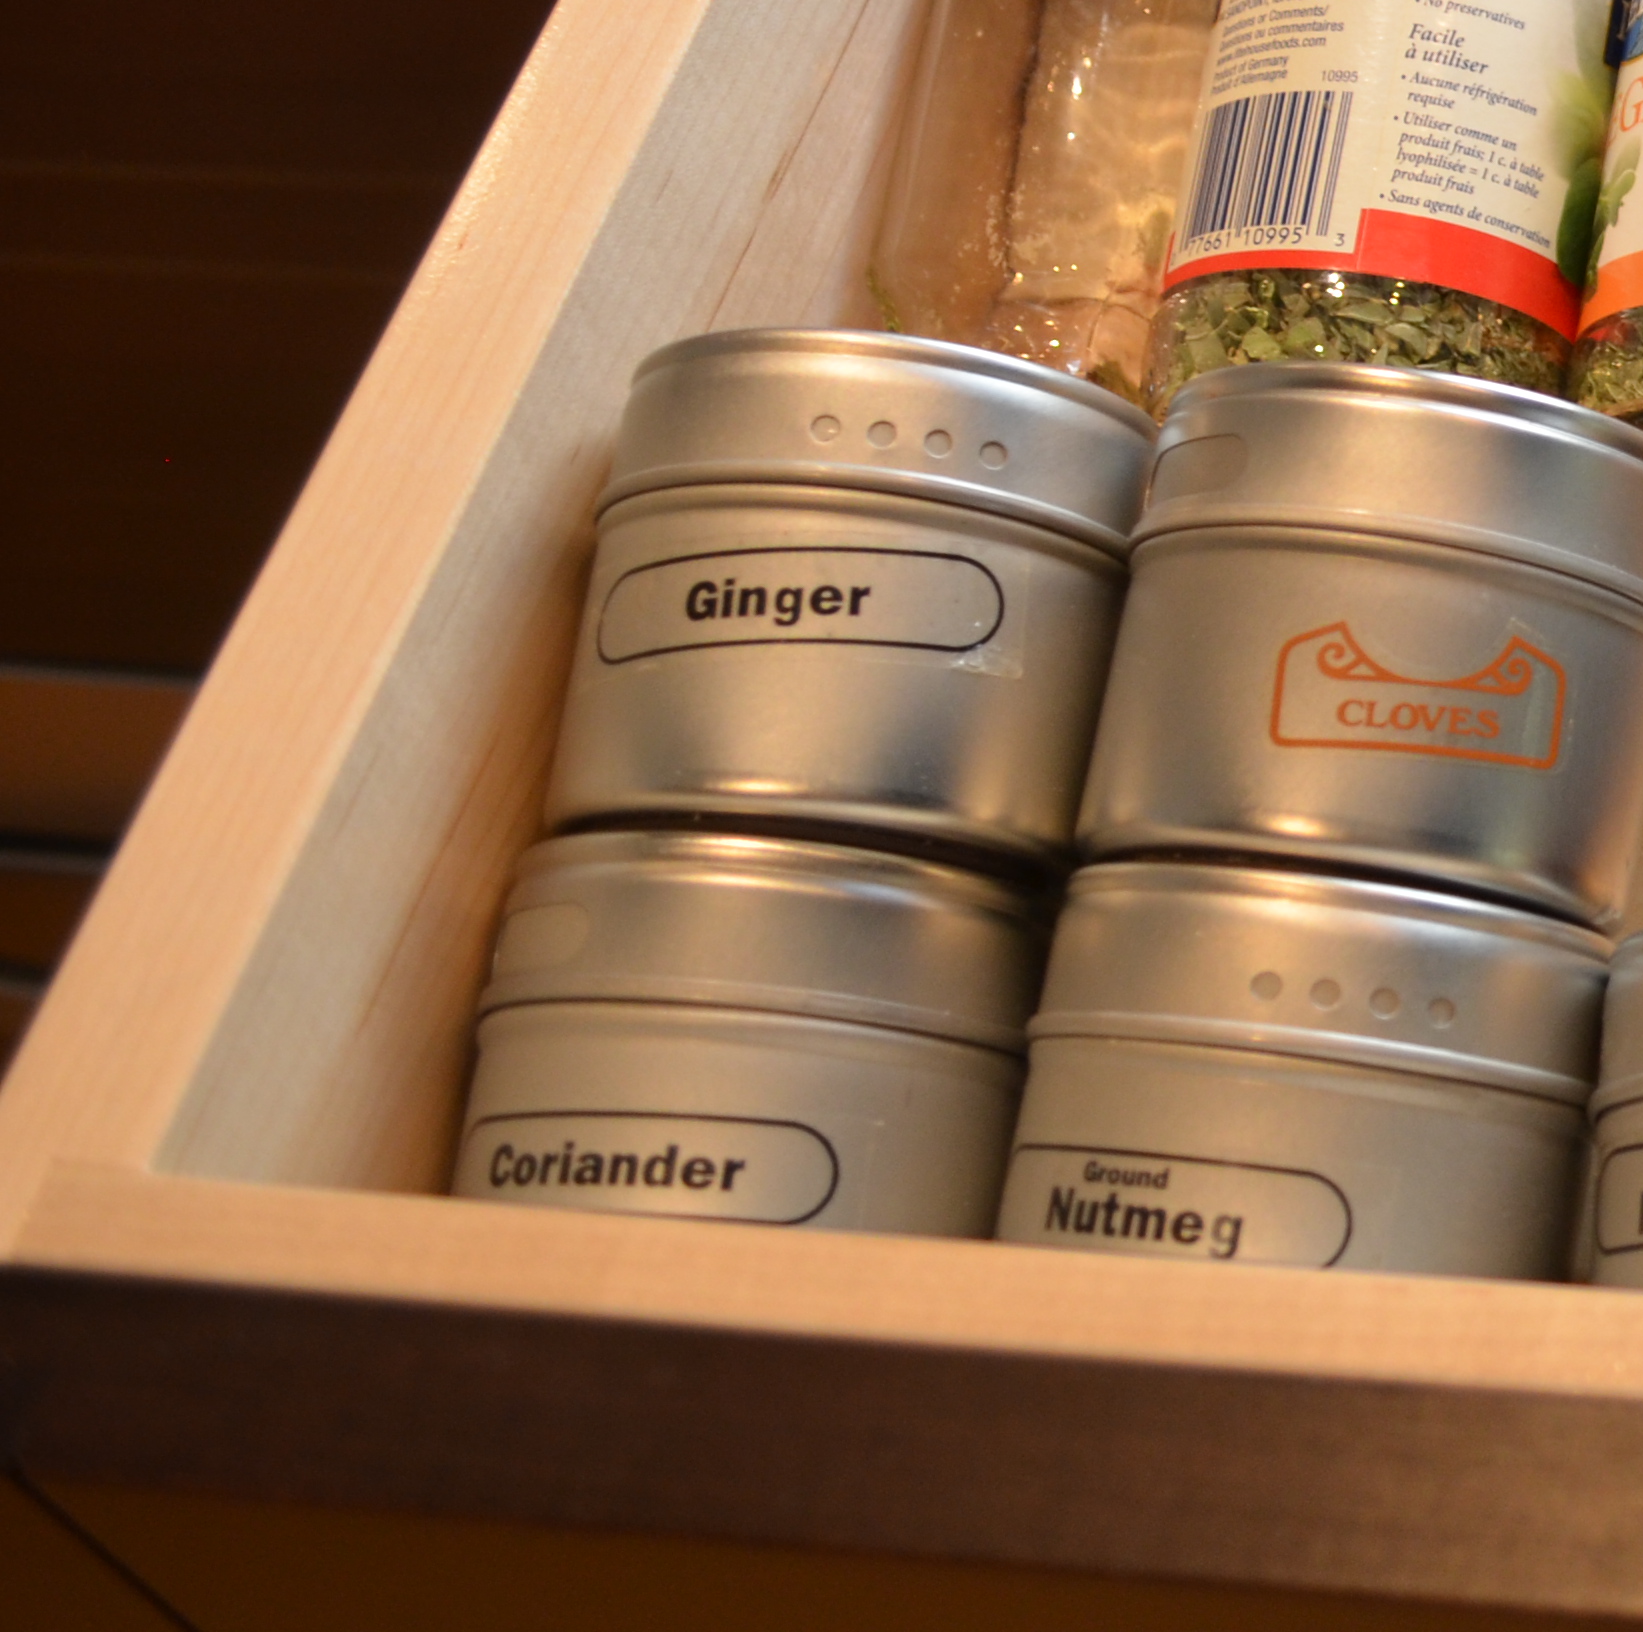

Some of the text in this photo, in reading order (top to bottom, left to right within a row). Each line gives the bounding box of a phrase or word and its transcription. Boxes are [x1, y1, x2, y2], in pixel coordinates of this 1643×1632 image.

[1409, 23, 1466, 48] Facile
[1405, 43, 1489, 74] à utiliser
[1321, 70, 1359, 83] 10995
[1410, 72, 1460, 92] Aucune
[1407, 90, 1456, 110] requise
[1404, 111, 1518, 151] Utiliser comme un
[1396, 148, 1467, 176] lyophilisée
[1513, 178, 1540, 199] table
[1398, 132, 1450, 152] produit
[1519, 161, 1546, 182] table
[1391, 168, 1475, 195] produit frais
[1244, 226, 1303, 247] 10995
[1335, 233, 1346, 247] 3
[1388, 189, 1551, 249] Sans agents de conservation
[685, 578, 871, 627] Ginger
[1336, 699, 1500, 740] CLOVES
[489, 1141, 745, 1191] Coriander
[1083, 1160, 1170, 1191] Ground
[1045, 1185, 1244, 1260] Nutmeg
